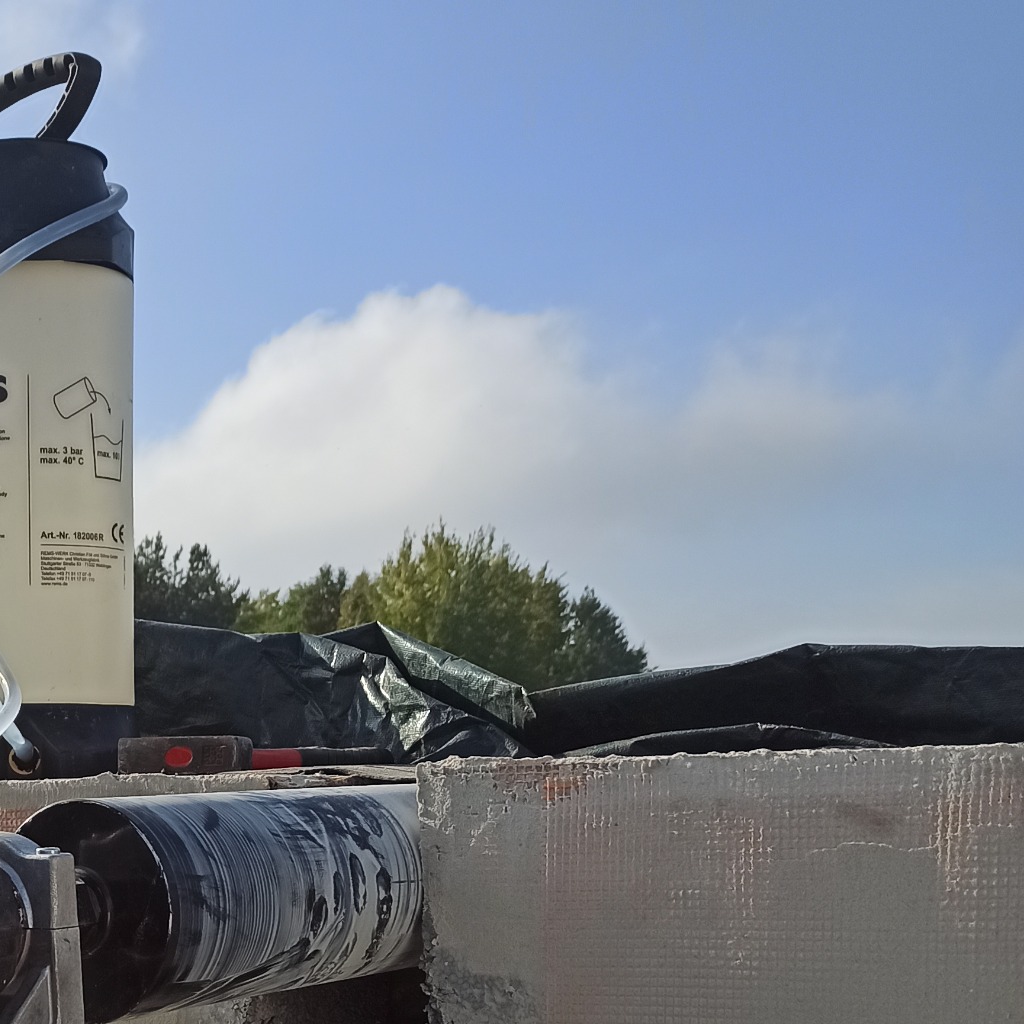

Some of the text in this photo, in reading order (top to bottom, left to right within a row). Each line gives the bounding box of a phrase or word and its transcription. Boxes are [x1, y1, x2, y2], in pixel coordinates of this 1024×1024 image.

[63, 446, 68, 454] 3
[70, 447, 83, 455] bar
[78, 457, 84, 465] C
[40, 531, 70, 540] Art.-Nr.
